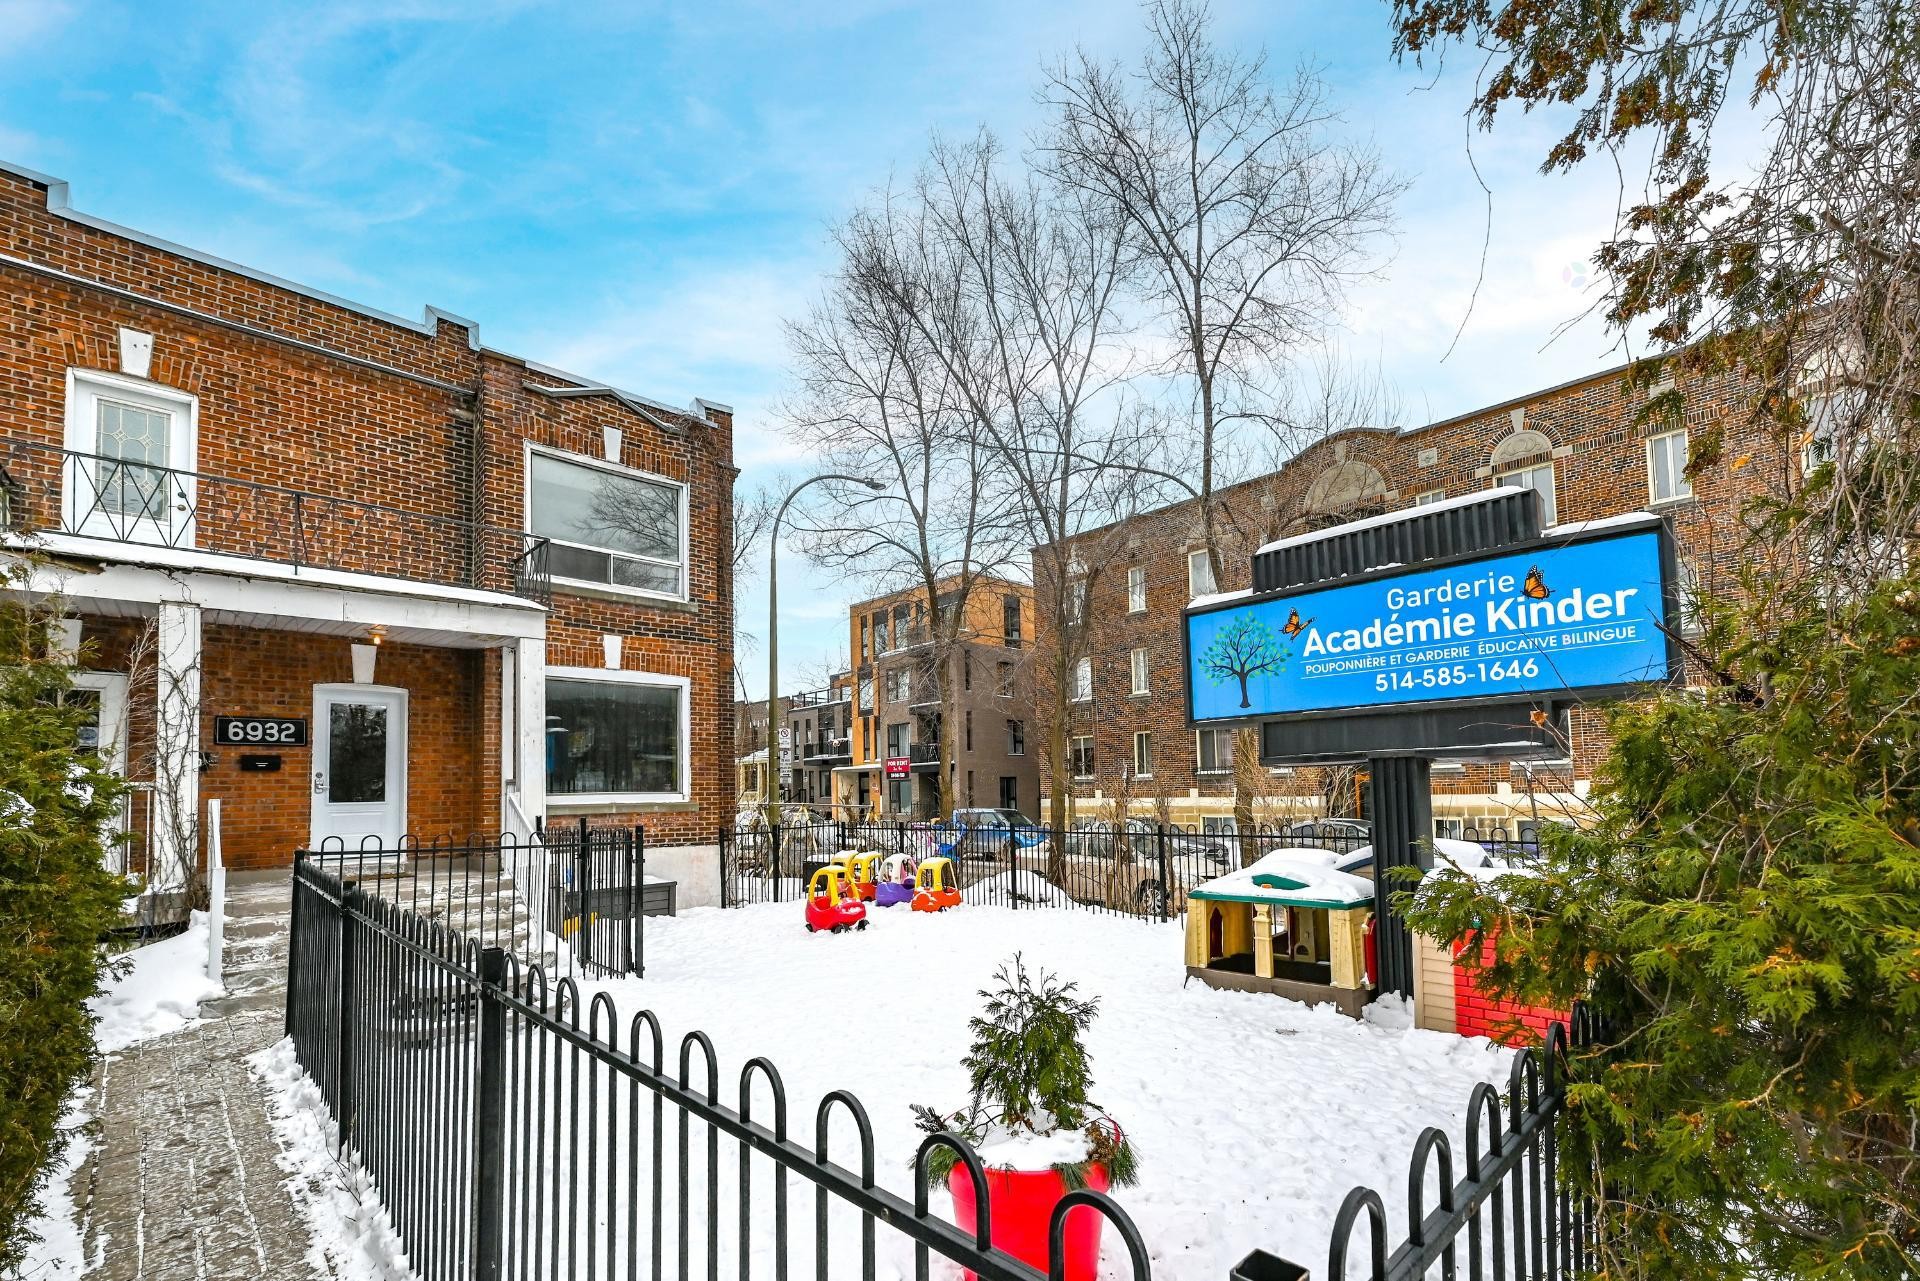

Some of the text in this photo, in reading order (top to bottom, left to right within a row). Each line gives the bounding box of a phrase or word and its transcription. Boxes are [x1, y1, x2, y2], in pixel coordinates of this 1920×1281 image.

[1387, 571, 1515, 610] Garderie
[1303, 587, 1640, 657] Académie Kinder
[1305, 626, 1636, 675] POUPONNIÈRE ET GARDERIE ÉDUCATIVE BILINGUE
[1375, 658, 1539, 691] 514-585-1646
[228, 721, 296, 742] 6932
